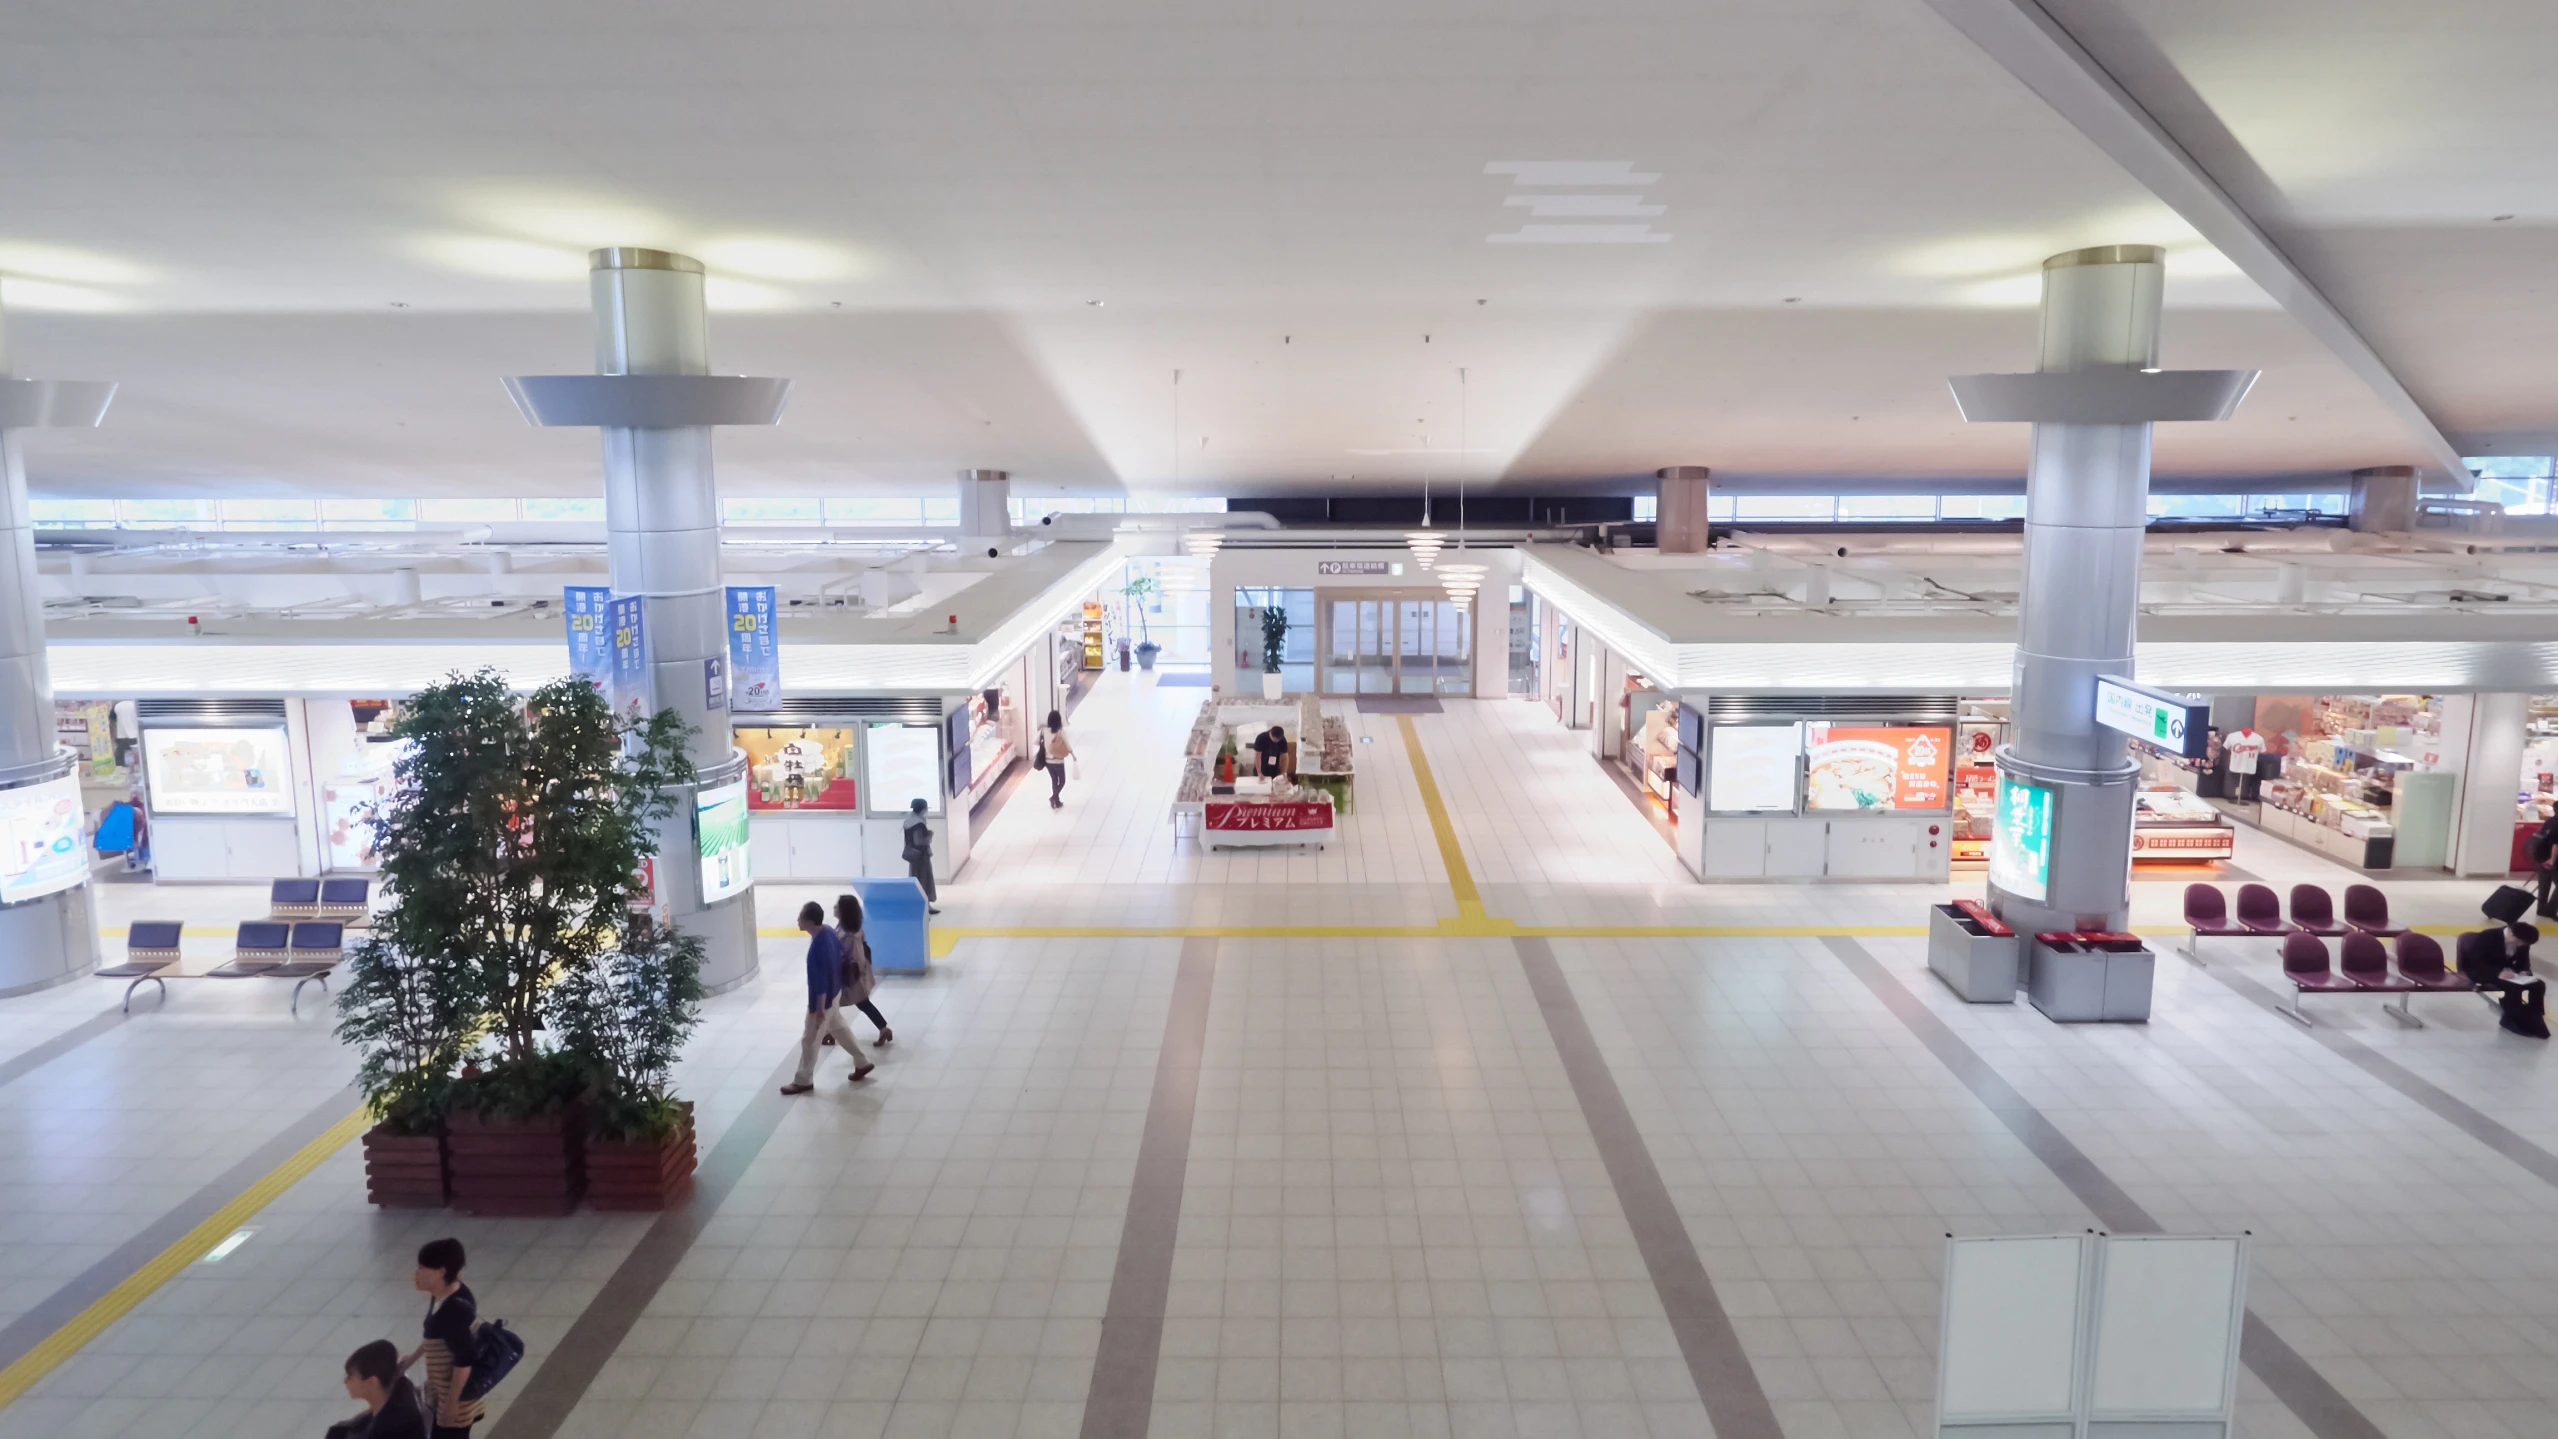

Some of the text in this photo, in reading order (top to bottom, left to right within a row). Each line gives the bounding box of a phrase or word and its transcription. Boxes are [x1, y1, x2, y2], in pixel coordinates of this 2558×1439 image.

[1212, 803, 1296, 829] Premium
[1237, 817, 1296, 829] プレミアム
